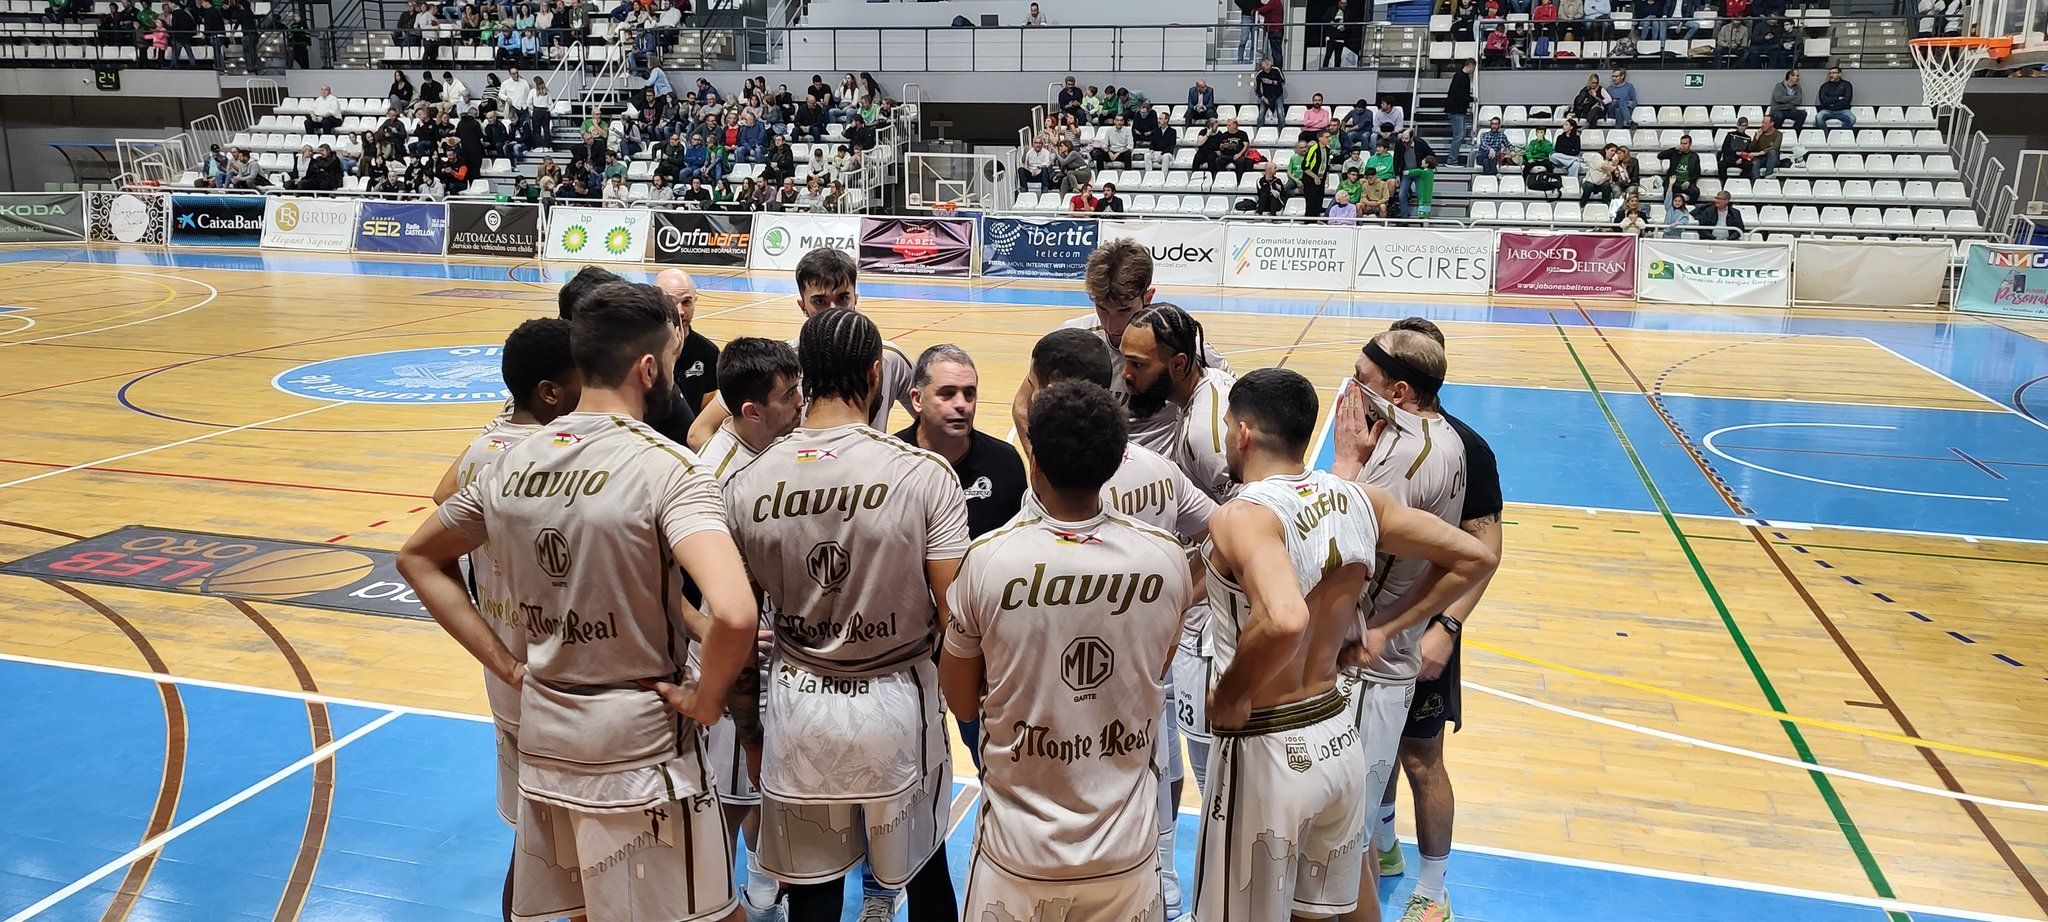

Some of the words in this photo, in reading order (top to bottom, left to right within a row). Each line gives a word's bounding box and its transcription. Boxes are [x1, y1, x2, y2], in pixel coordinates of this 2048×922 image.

[99, 72, 115, 83] 24
[197, 214, 265, 231] CaixaBank
[302, 211, 347, 225] GRUPO
[581, 213, 592, 223] bp
[625, 215, 636, 225] bp
[362, 221, 401, 237] SER
[1028, 226, 1093, 246] ibertic
[800, 233, 856, 250] MARZÁ
[1256, 237, 1295, 246] Comunitat
[1385, 243, 1427, 254] CLÍNICAS
[1429, 245, 1487, 255] BIOMÉDICAS
[1035, 250, 1080, 258] telecom
[1145, 242, 1214, 262] udex
[1255, 246, 1336, 260] COMUNITAT
[1506, 248, 1561, 260] JABONES
[1260, 260, 1276, 271] DE
[1358, 244, 1487, 280] ASCIRES
[1560, 248, 1626, 275] BELTRÁN
[1676, 263, 1780, 278] VALFORTEC
[1517, 282, 1612, 292] www.jabonesbeltran.com
[47, 551, 214, 581] LEB
[562, 608, 619, 647] Real
[843, 611, 897, 646] Real
[798, 676, 816, 692] La
[821, 676, 869, 697] Rioja
[1074, 693, 1097, 702] GARTE
[1178, 699, 1194, 726] 23
[1011, 720, 1092, 765] Monte
[1099, 718, 1151, 757] Real
